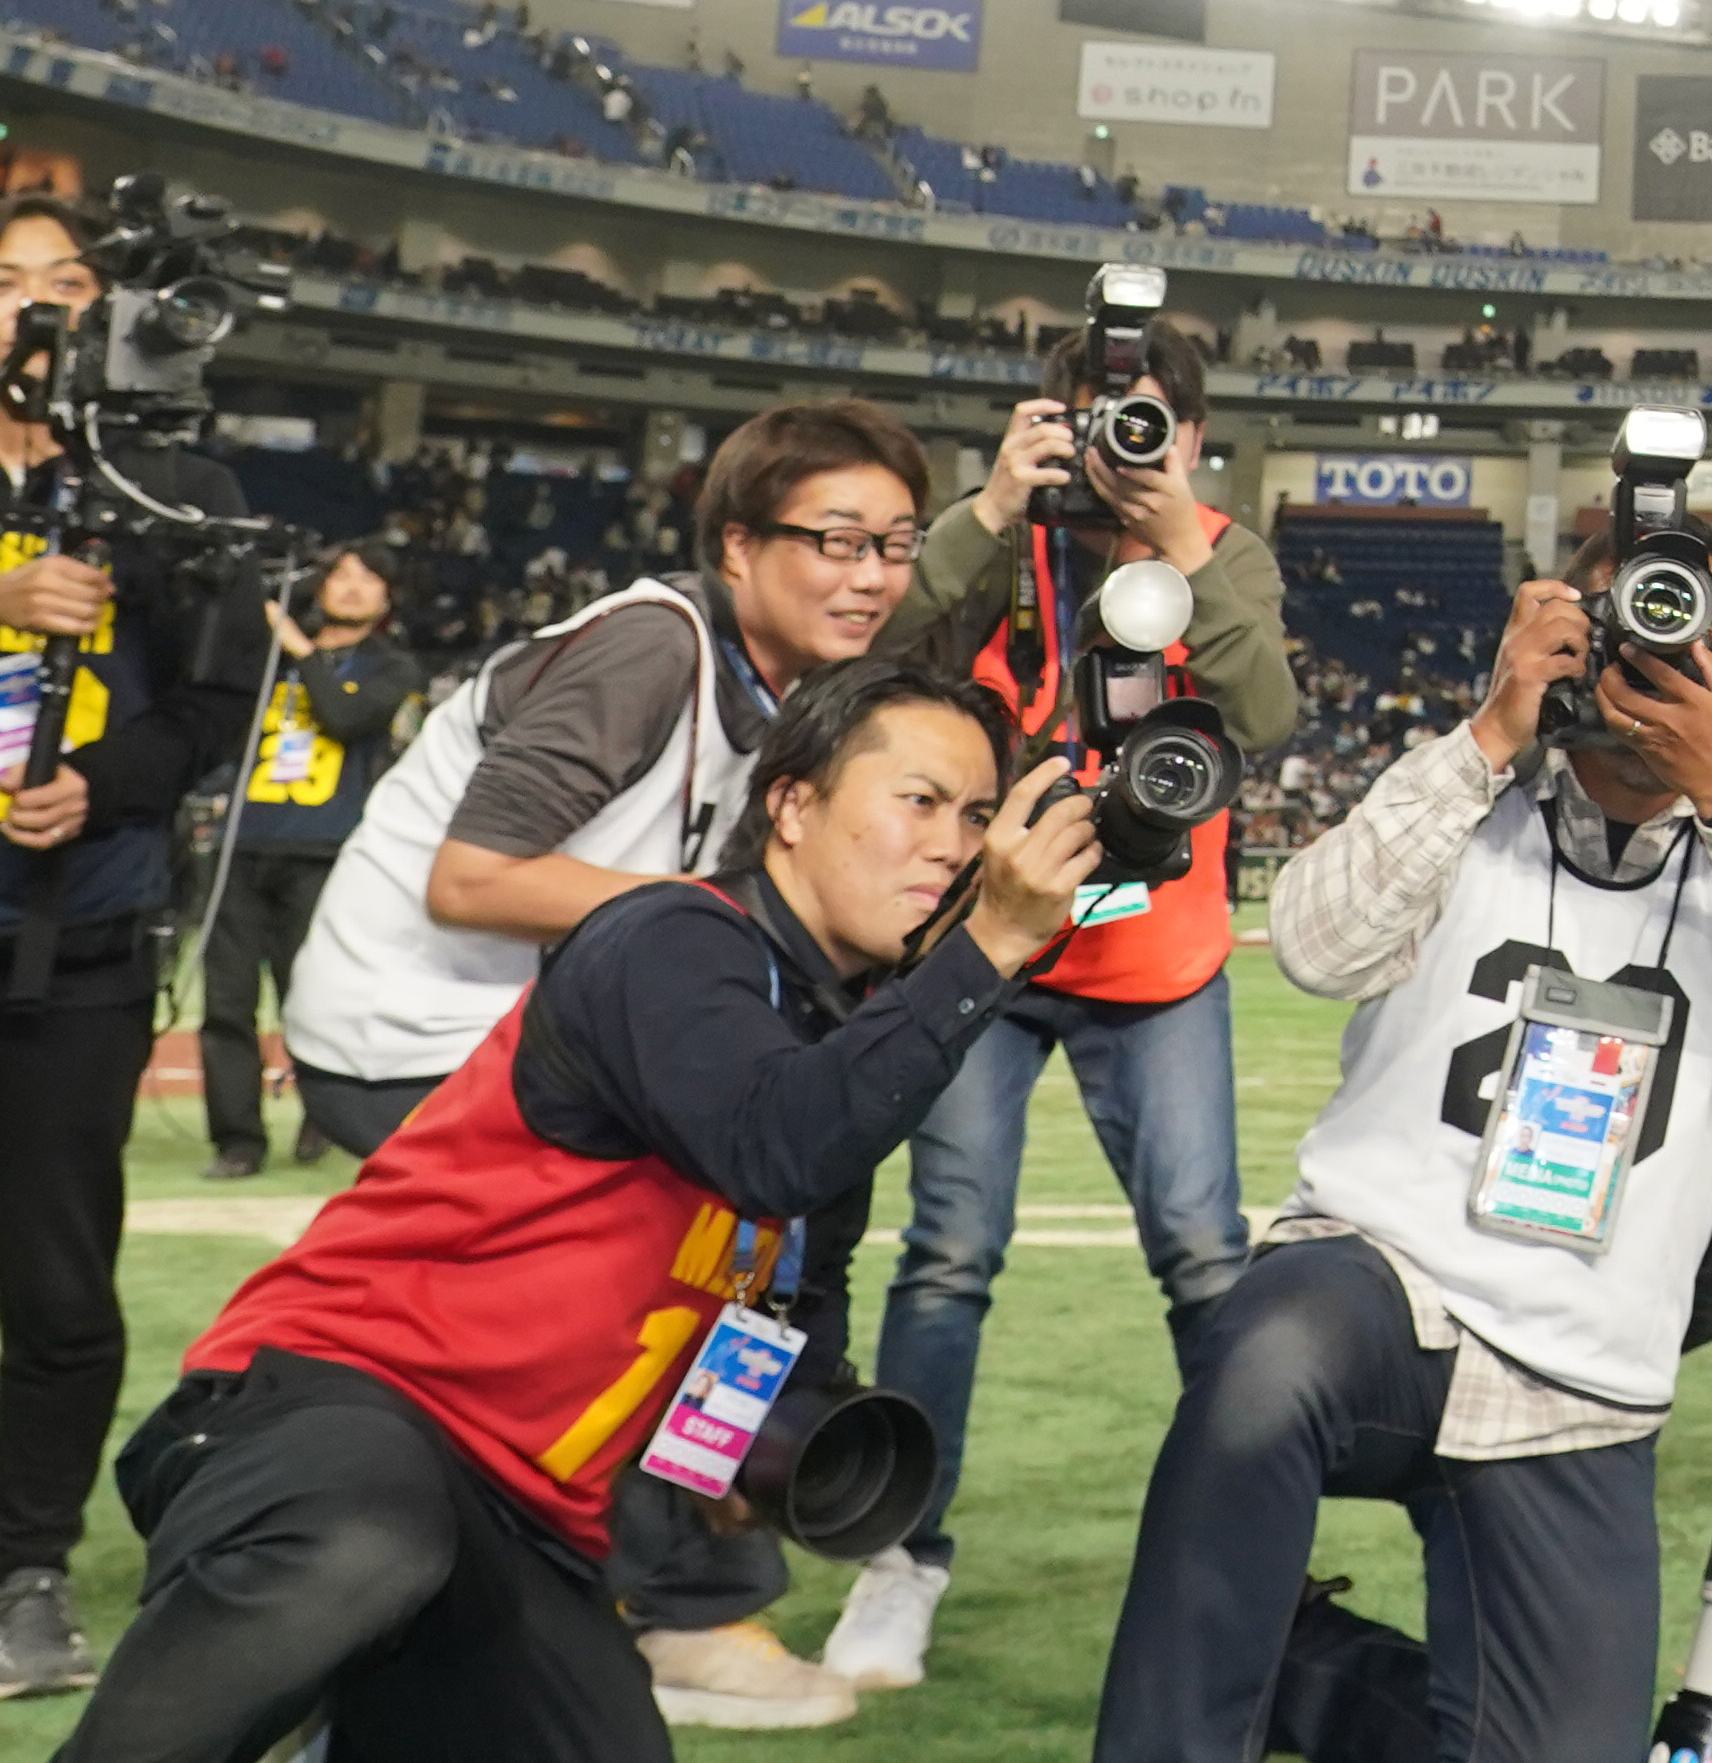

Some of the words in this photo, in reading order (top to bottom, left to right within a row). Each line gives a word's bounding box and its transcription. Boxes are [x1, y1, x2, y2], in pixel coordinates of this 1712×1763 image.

[824, 0, 972, 43] ALSOK
[1375, 66, 1577, 132] PARK
[1295, 253, 1413, 286] DUSKIN
[1429, 261, 1546, 293] DUSKIN
[1320, 460, 1469, 502] TOTO
[680, 1415, 735, 1449] STAFF
